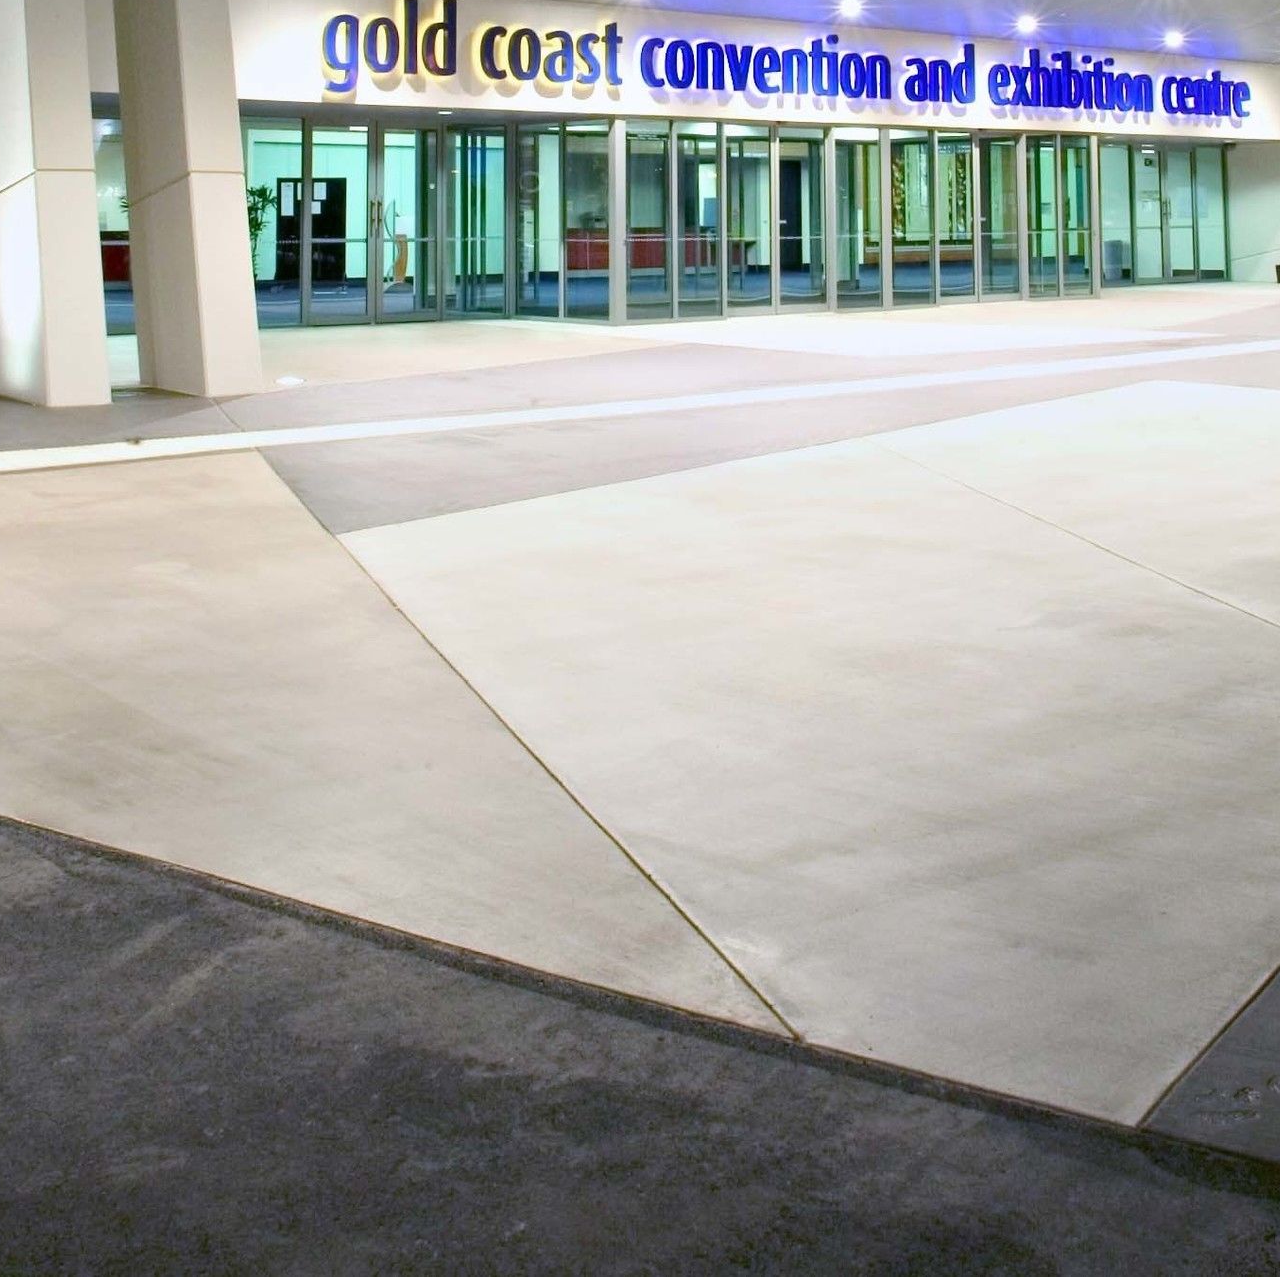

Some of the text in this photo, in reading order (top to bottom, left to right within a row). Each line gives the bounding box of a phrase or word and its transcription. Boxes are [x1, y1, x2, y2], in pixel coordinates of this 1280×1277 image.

[479, 22, 623, 85] coast
[640, 34, 891, 99] convention
[904, 43, 975, 104] and
[987, 48, 1154, 112] exhibition
[1161, 71, 1251, 117] centre
